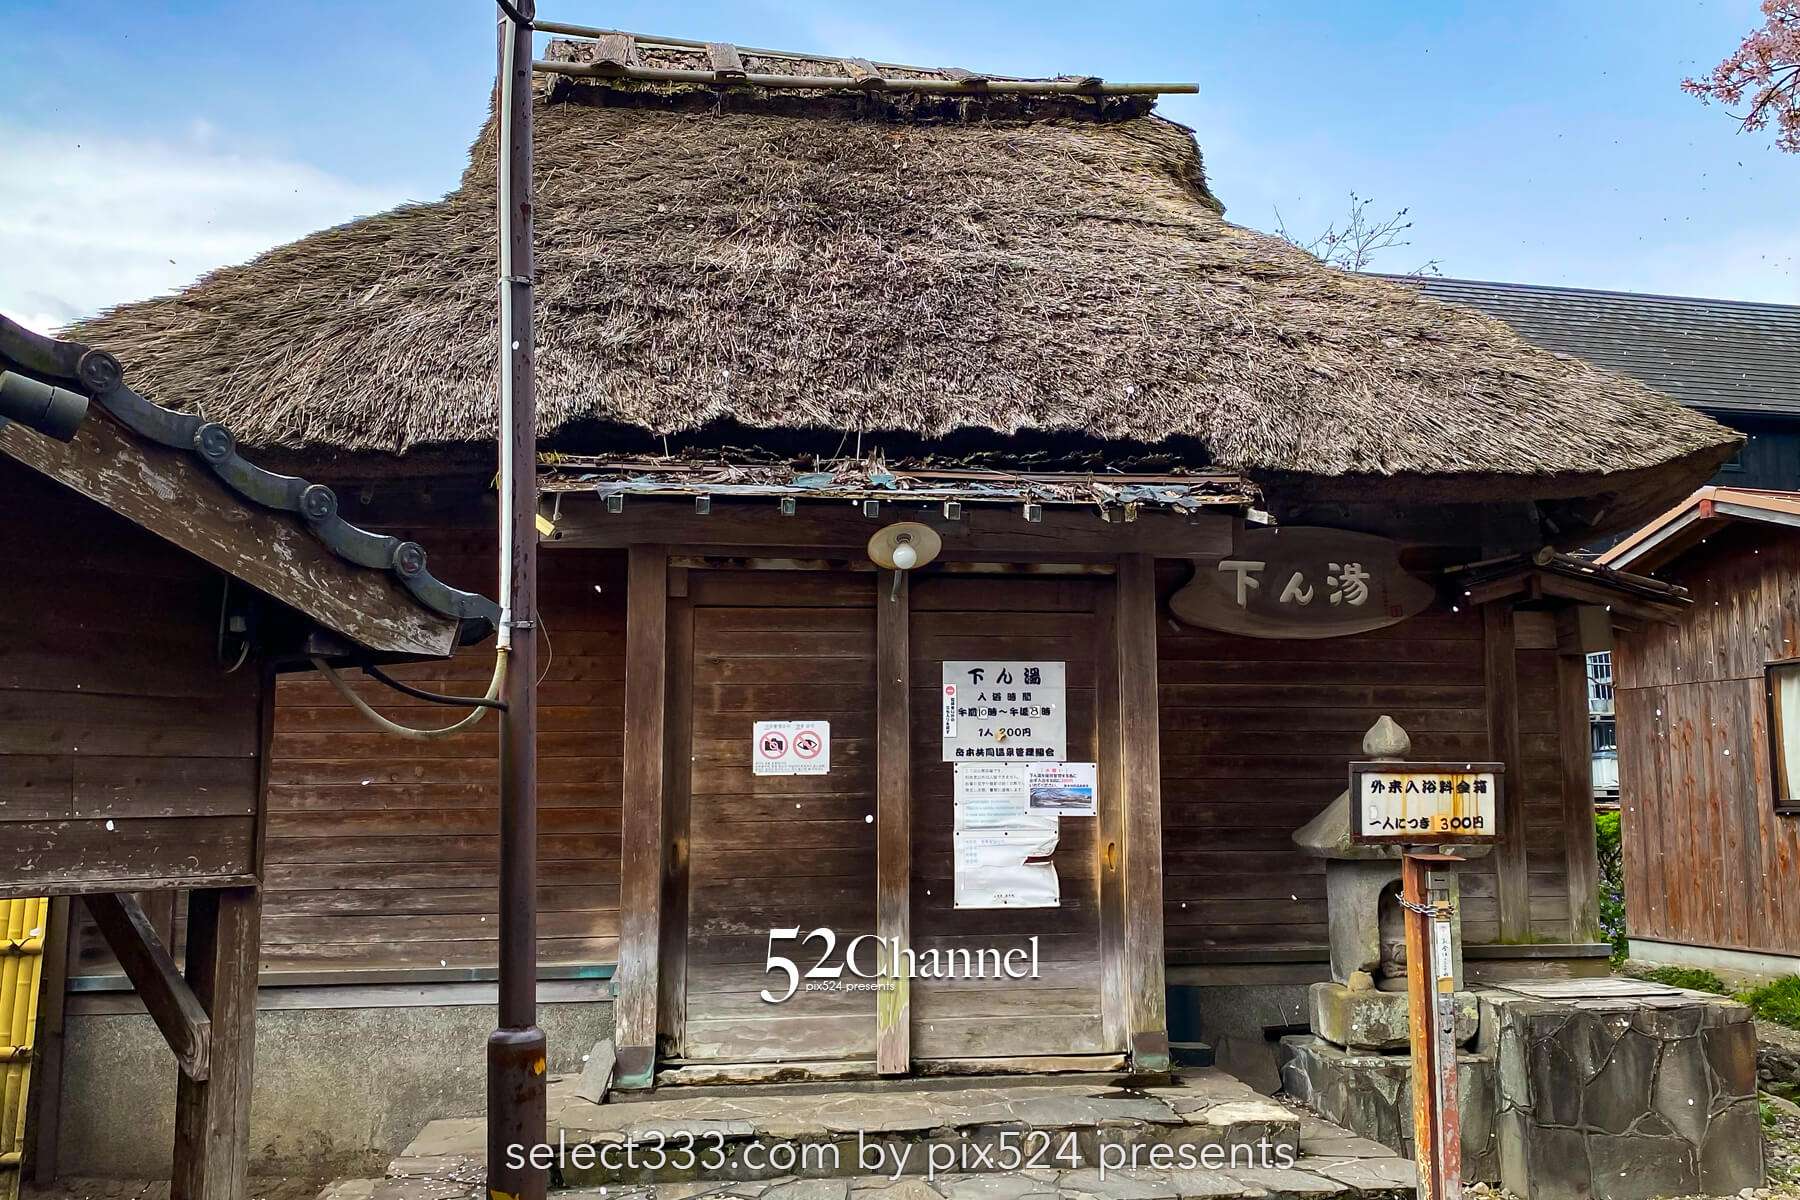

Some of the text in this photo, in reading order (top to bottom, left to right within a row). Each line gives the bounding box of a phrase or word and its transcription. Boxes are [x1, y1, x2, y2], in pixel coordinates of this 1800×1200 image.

[1218, 560, 1370, 608] 下ん湯
[967, 667, 1041, 685] 下ん湯
[1370, 780, 1488, 794] 外来入浴料金箱
